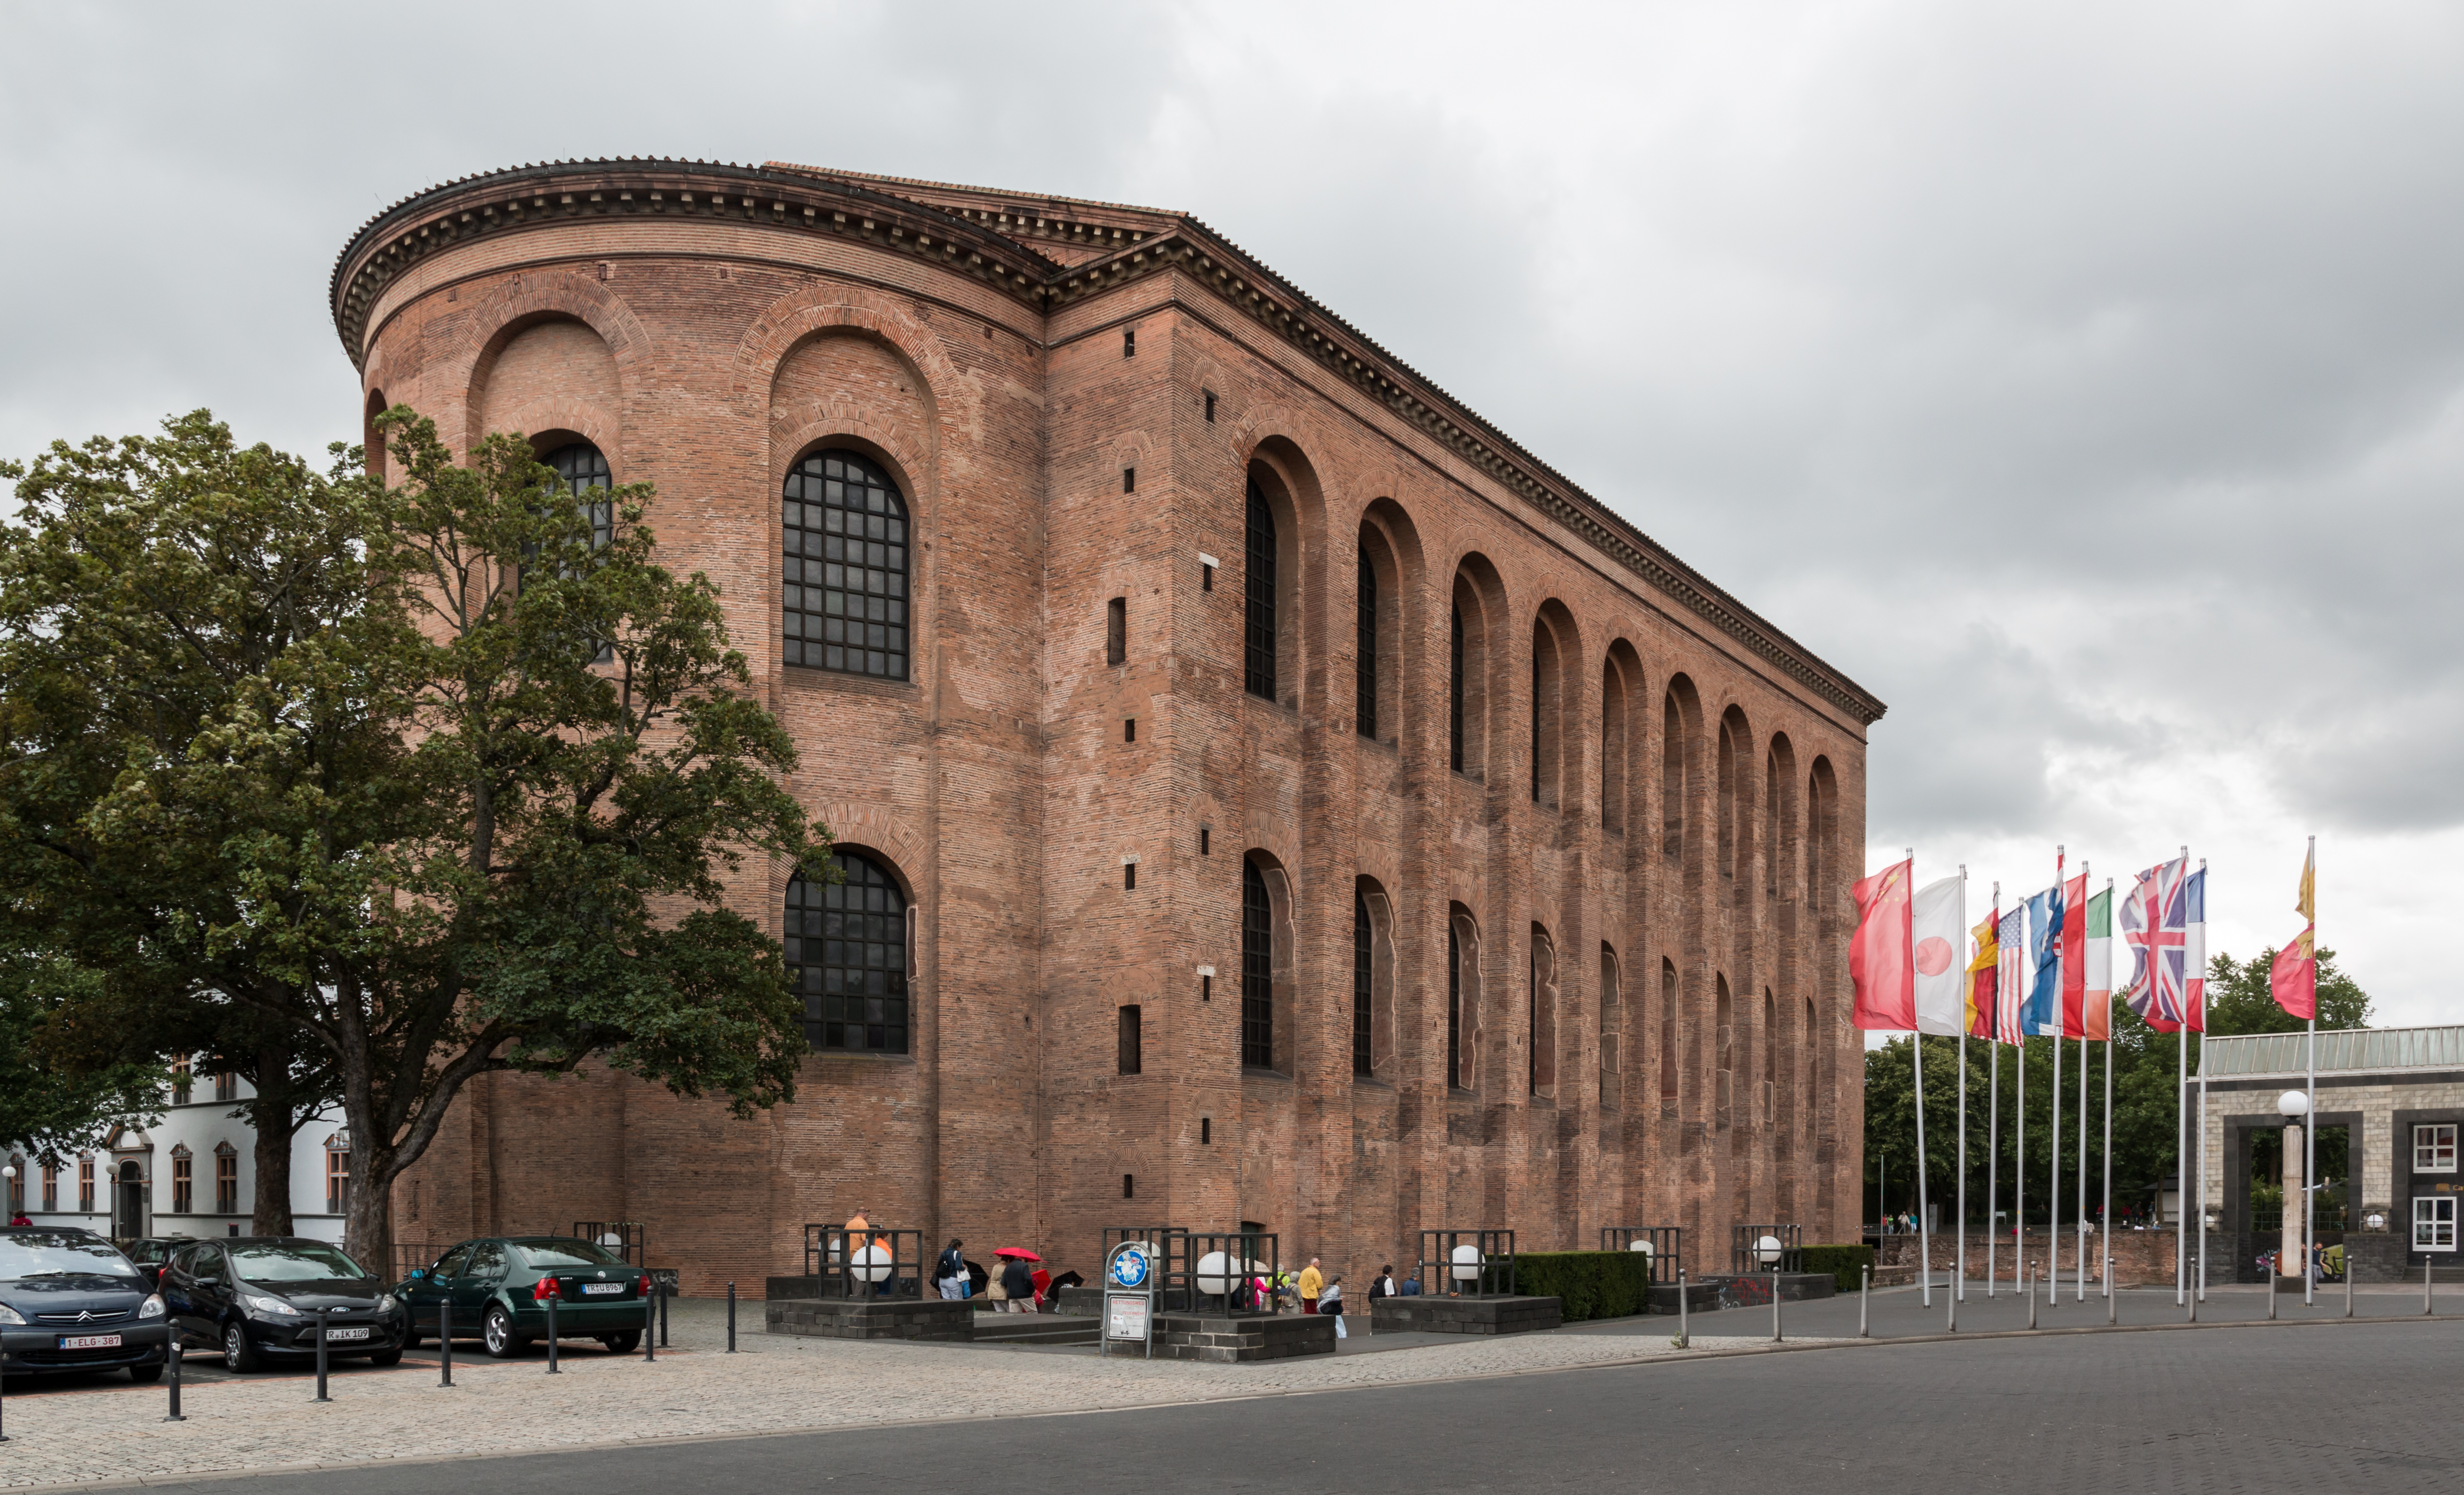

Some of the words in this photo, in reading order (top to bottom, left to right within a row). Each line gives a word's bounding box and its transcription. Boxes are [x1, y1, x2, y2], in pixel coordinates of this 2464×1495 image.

[341, 1330, 351, 1338] IK
[353, 1329, 368, 1338] 109
[68, 1337, 119, 1347] 1-ELG-387
